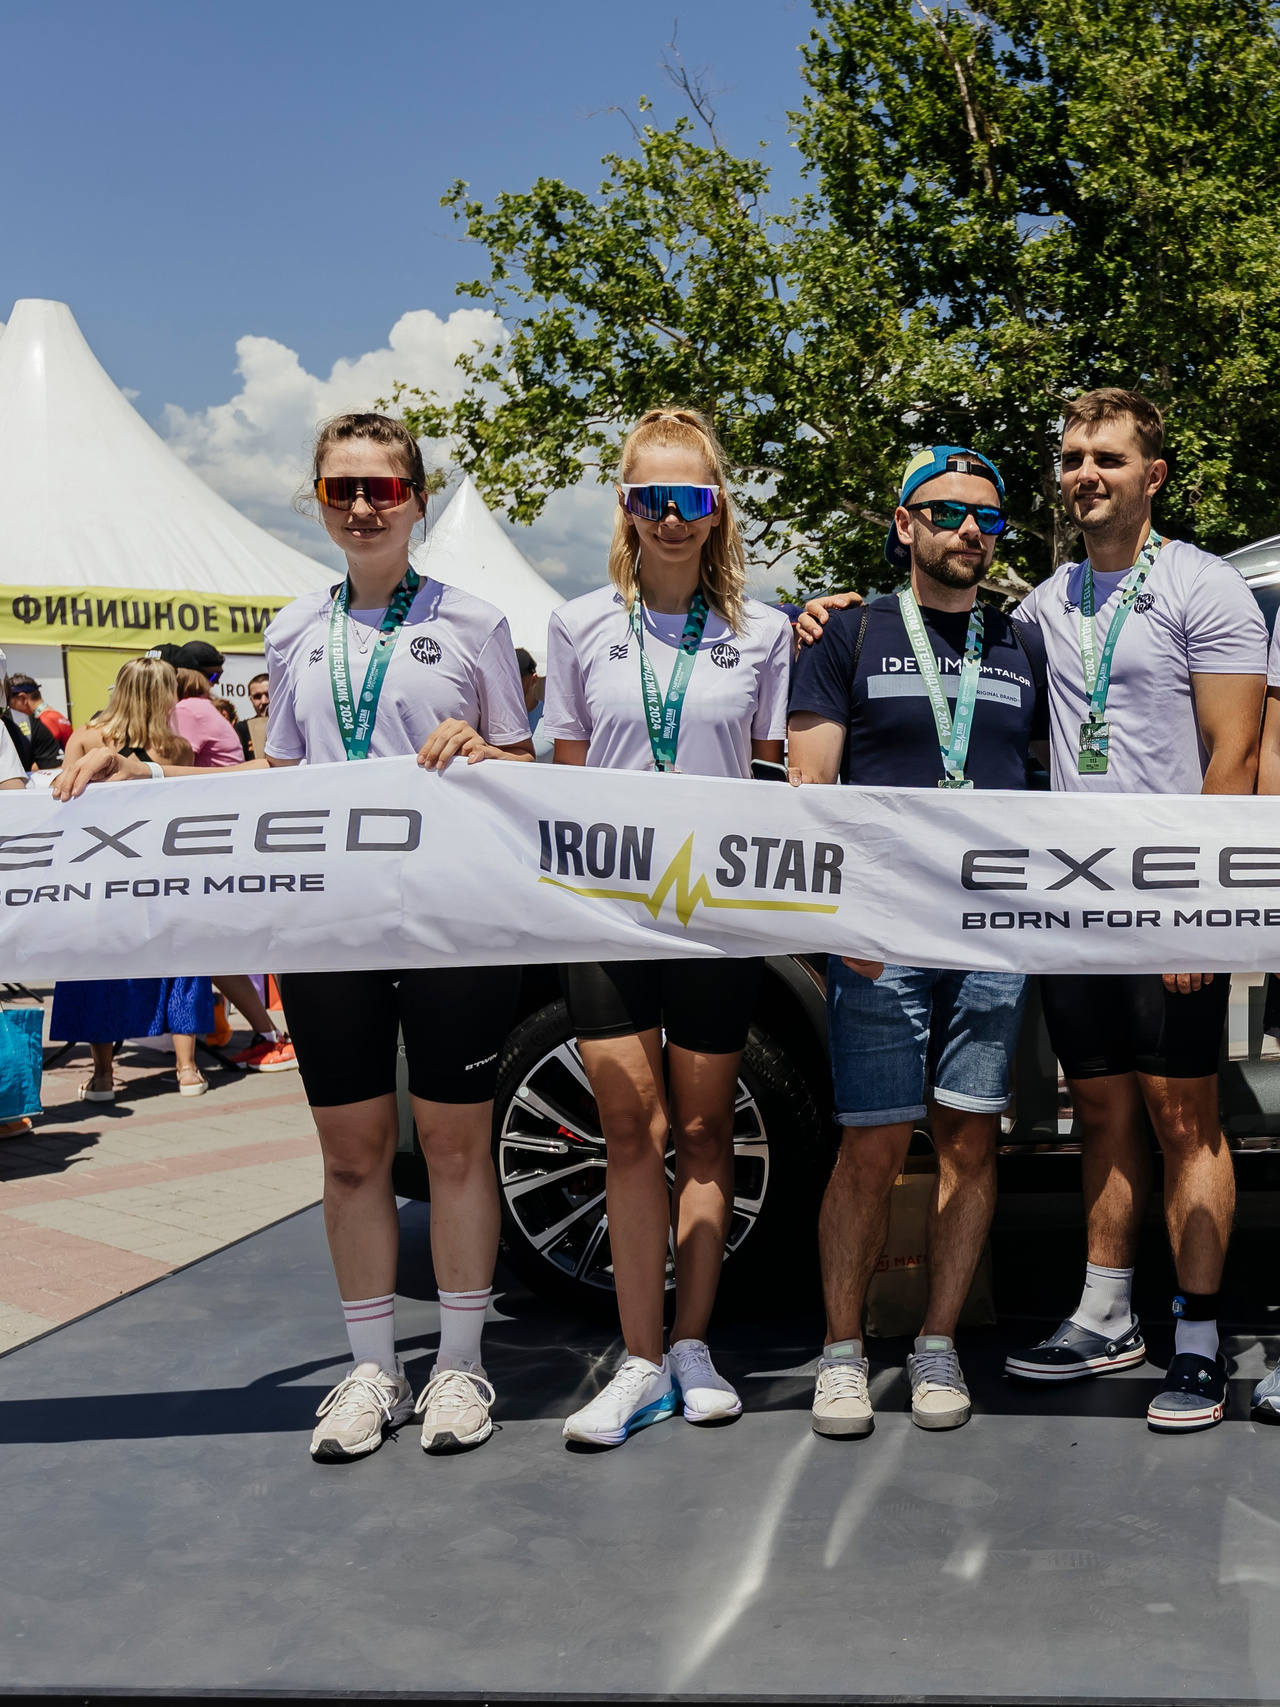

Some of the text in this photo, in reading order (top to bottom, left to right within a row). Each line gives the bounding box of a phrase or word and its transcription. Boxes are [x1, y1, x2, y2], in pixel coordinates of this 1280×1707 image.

[1083, 585, 1091, 599] 113
[12, 593, 283, 633] ФИНИШНОЕ ПИ
[1081, 600, 1092, 656] ГЕЛЕНДЖИК
[332, 642, 349, 703] ГЕЛЕНДЖИК
[882, 657, 962, 672] DEIM
[994, 668, 1031, 687] TAILOR
[901, 591, 952, 737] IRONSTAR 113 ГЕЛЕНДЖИК 2024
[1084, 657, 1096, 683] 2024
[221, 684, 247, 697] IRO
[977, 689, 1018, 703] RIGINAL BRAND
[340, 704, 355, 730] 2024
[649, 706, 661, 730] 2024
[0, 809, 422, 870] EXEED
[539, 820, 844, 894] IRON STAR
[0, 873, 325, 907] ORN FOR MORE
[962, 910, 1070, 929] BORN
[1083, 910, 1160, 928] FOR
